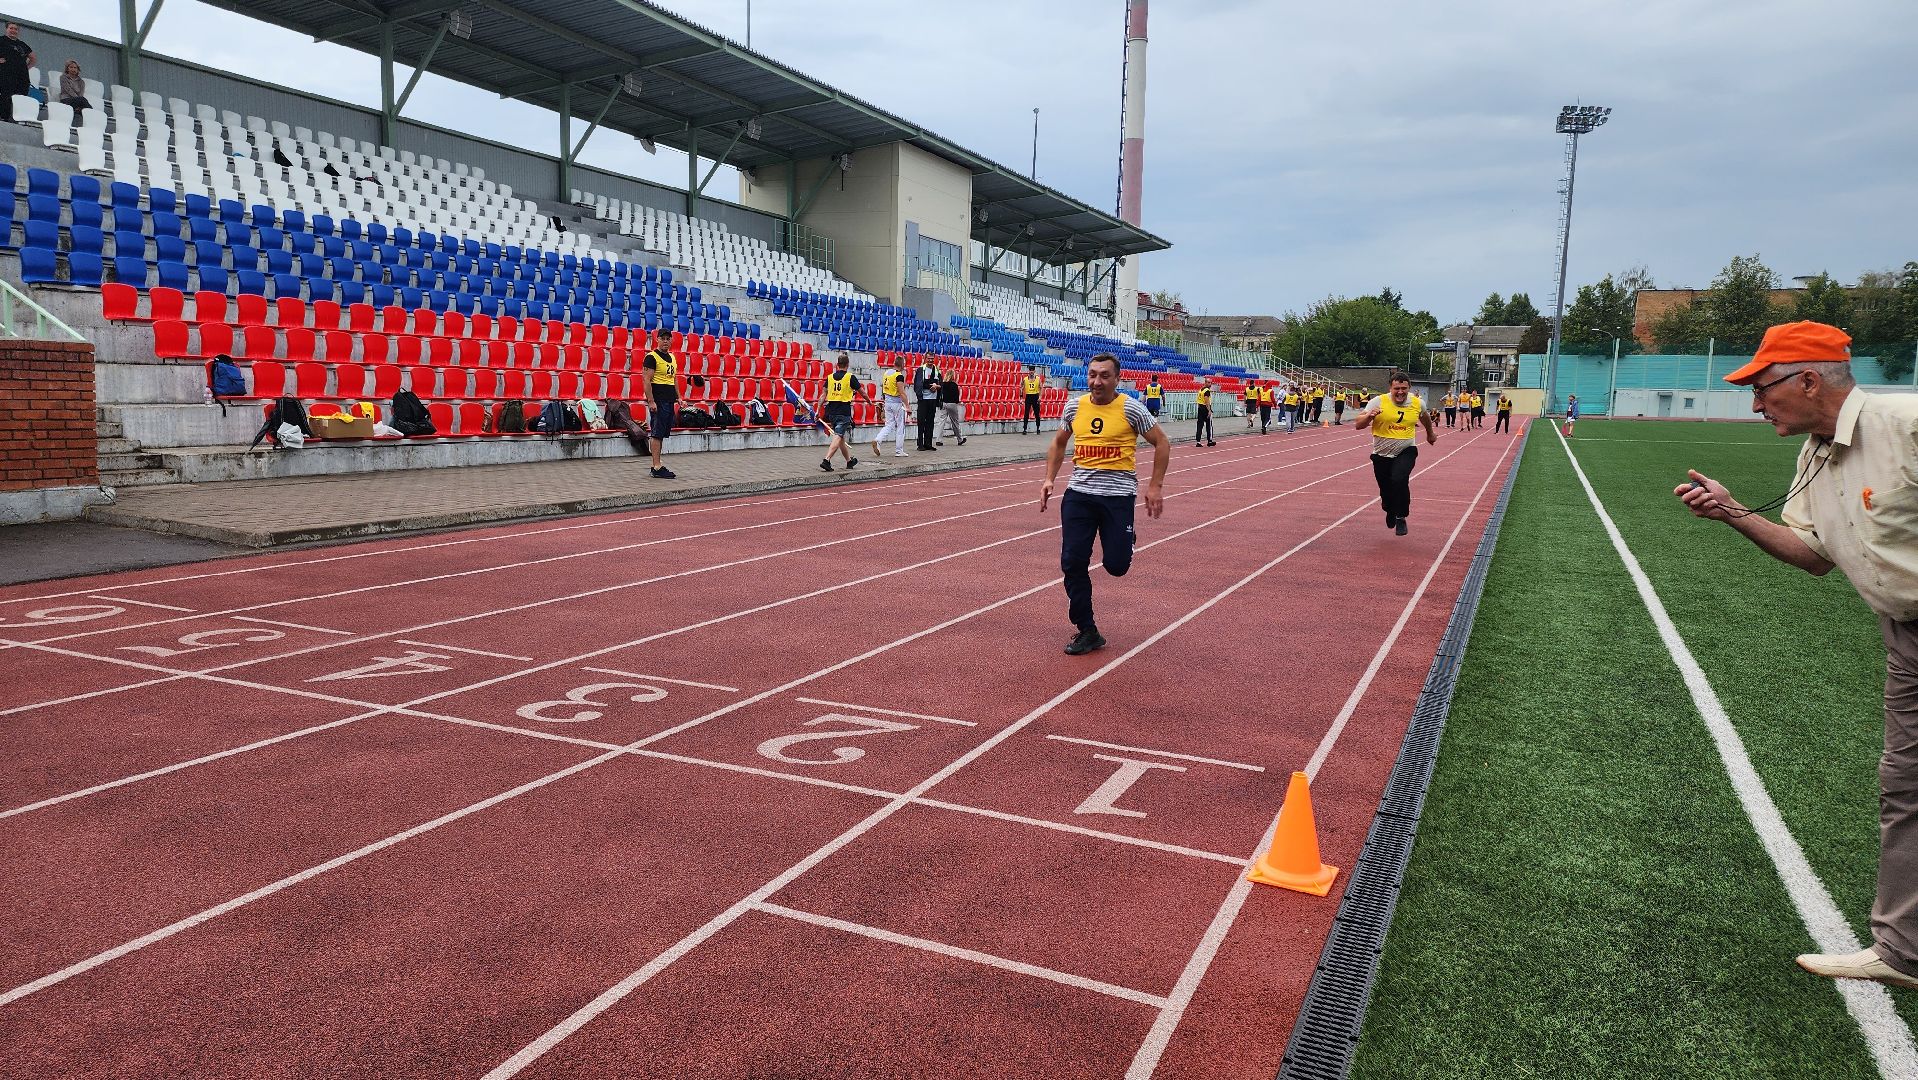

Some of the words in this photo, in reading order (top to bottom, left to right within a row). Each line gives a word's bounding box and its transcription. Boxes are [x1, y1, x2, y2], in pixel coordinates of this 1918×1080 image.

[1090, 417, 1104, 434] 9
[1396, 410, 1404, 423] 7
[1075, 445, 1121, 458] КАШИРА
[117, 628, 286, 657] 5
[304, 650, 453, 683] 4
[516, 682, 669, 723] 3
[756, 713, 922, 765] 2
[1073, 753, 1188, 819] 1
